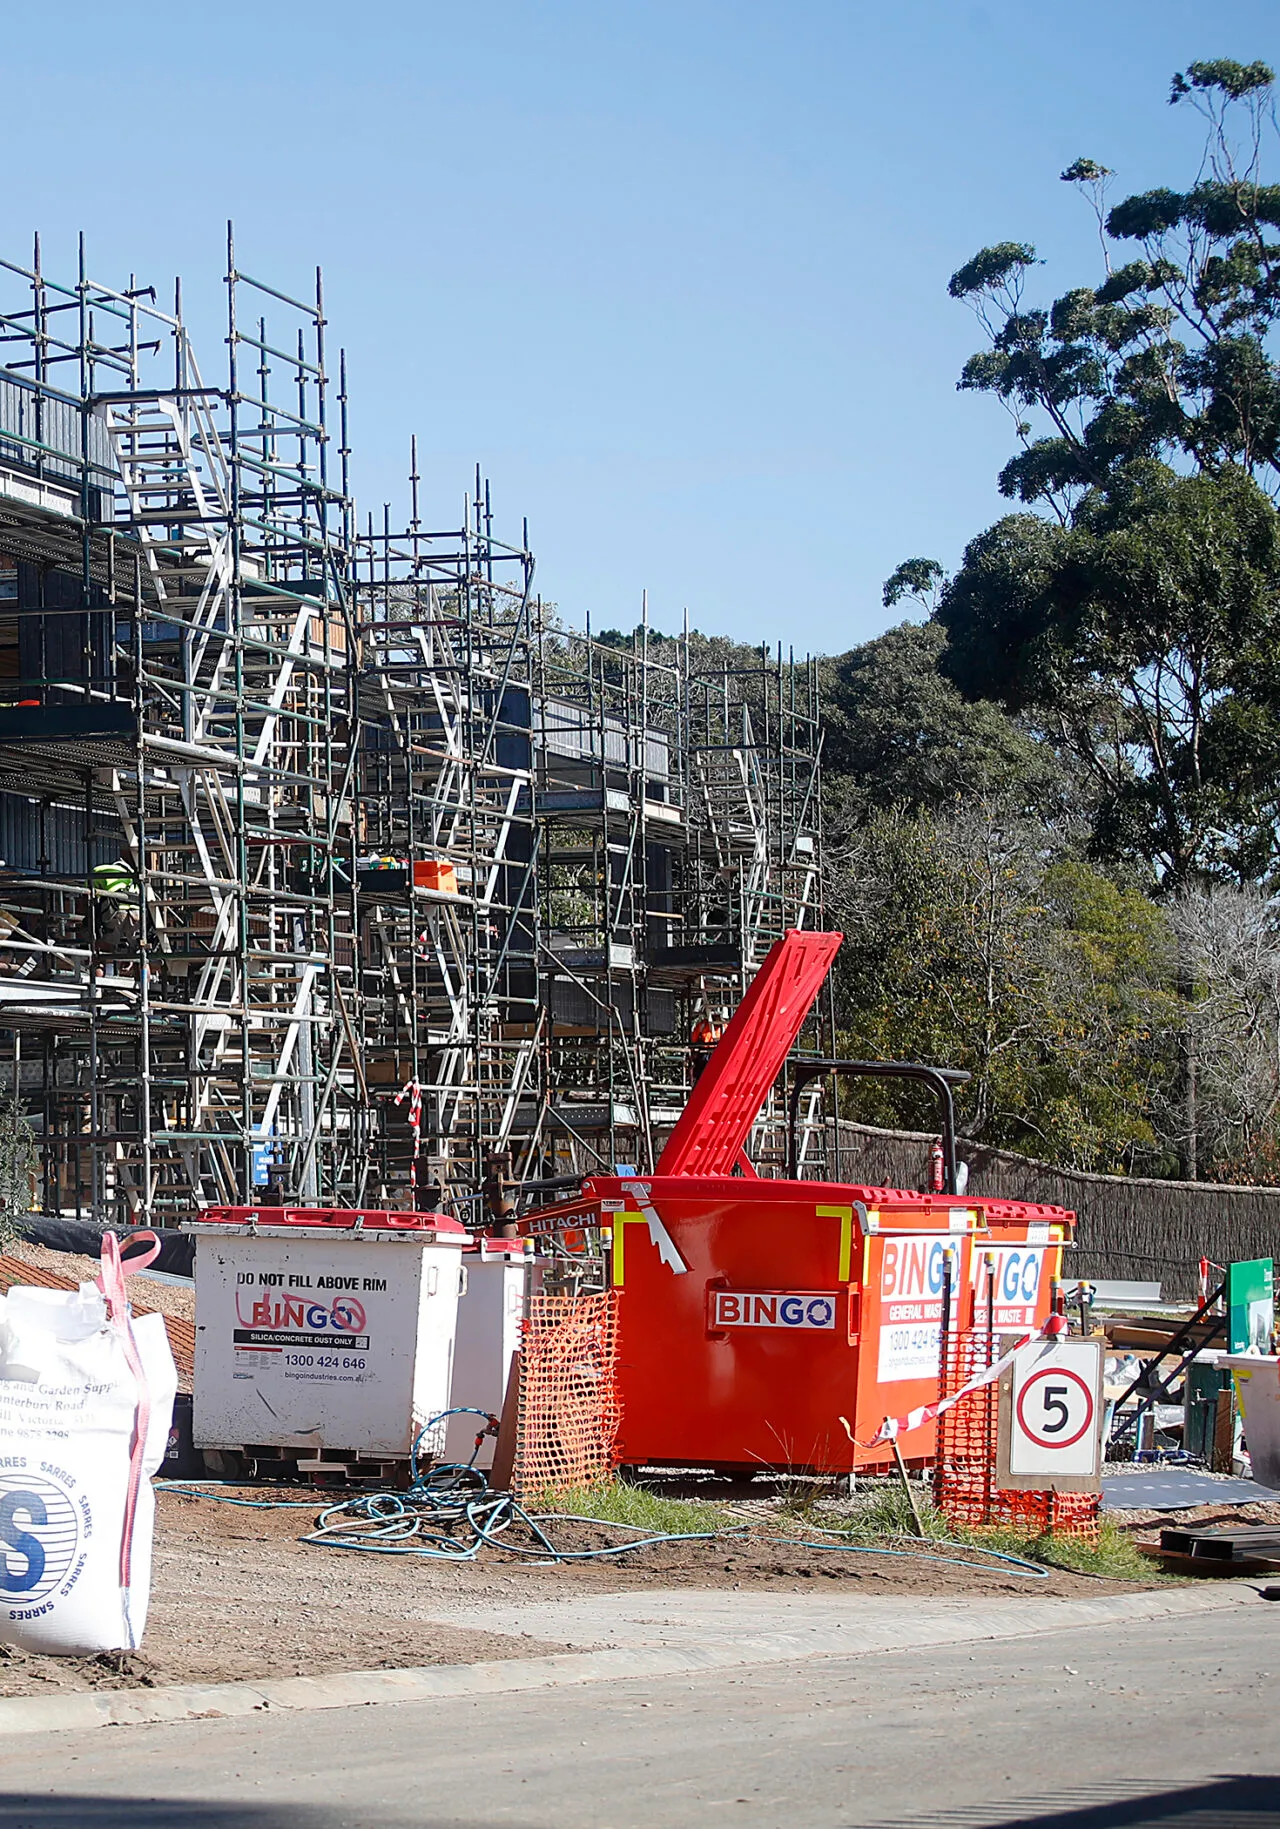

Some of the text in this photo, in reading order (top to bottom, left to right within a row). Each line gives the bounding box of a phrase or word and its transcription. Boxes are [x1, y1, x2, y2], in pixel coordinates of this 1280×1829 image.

[529, 1212, 597, 1233] HITACHI
[882, 1241, 960, 1297] BINGO
[975, 1252, 1040, 1301] INGO
[237, 1272, 387, 1292] DO NOT FILL ABOVE RIM
[252, 1302, 353, 1330] BINGO
[719, 1295, 832, 1326] BINGO
[889, 1304, 923, 1321] GENERAL
[997, 1309, 1023, 1324] WASTE
[250, 1333, 353, 1346] SILICA/CONCRETE DUST ONLY
[285, 1354, 314, 1367] 1300
[316, 1356, 339, 1368] 424
[342, 1358, 366, 1369] 646
[38, 1384, 80, 1396] Garden
[55, 1400, 85, 1411] Road
[1042, 1386, 1069, 1433] 5
[40, 1461, 77, 1489] SARRES
[78, 1495, 93, 1539] SARRES
[60, 1553, 88, 1597] SARRES
[9, 1601, 55, 1621] SARRES
